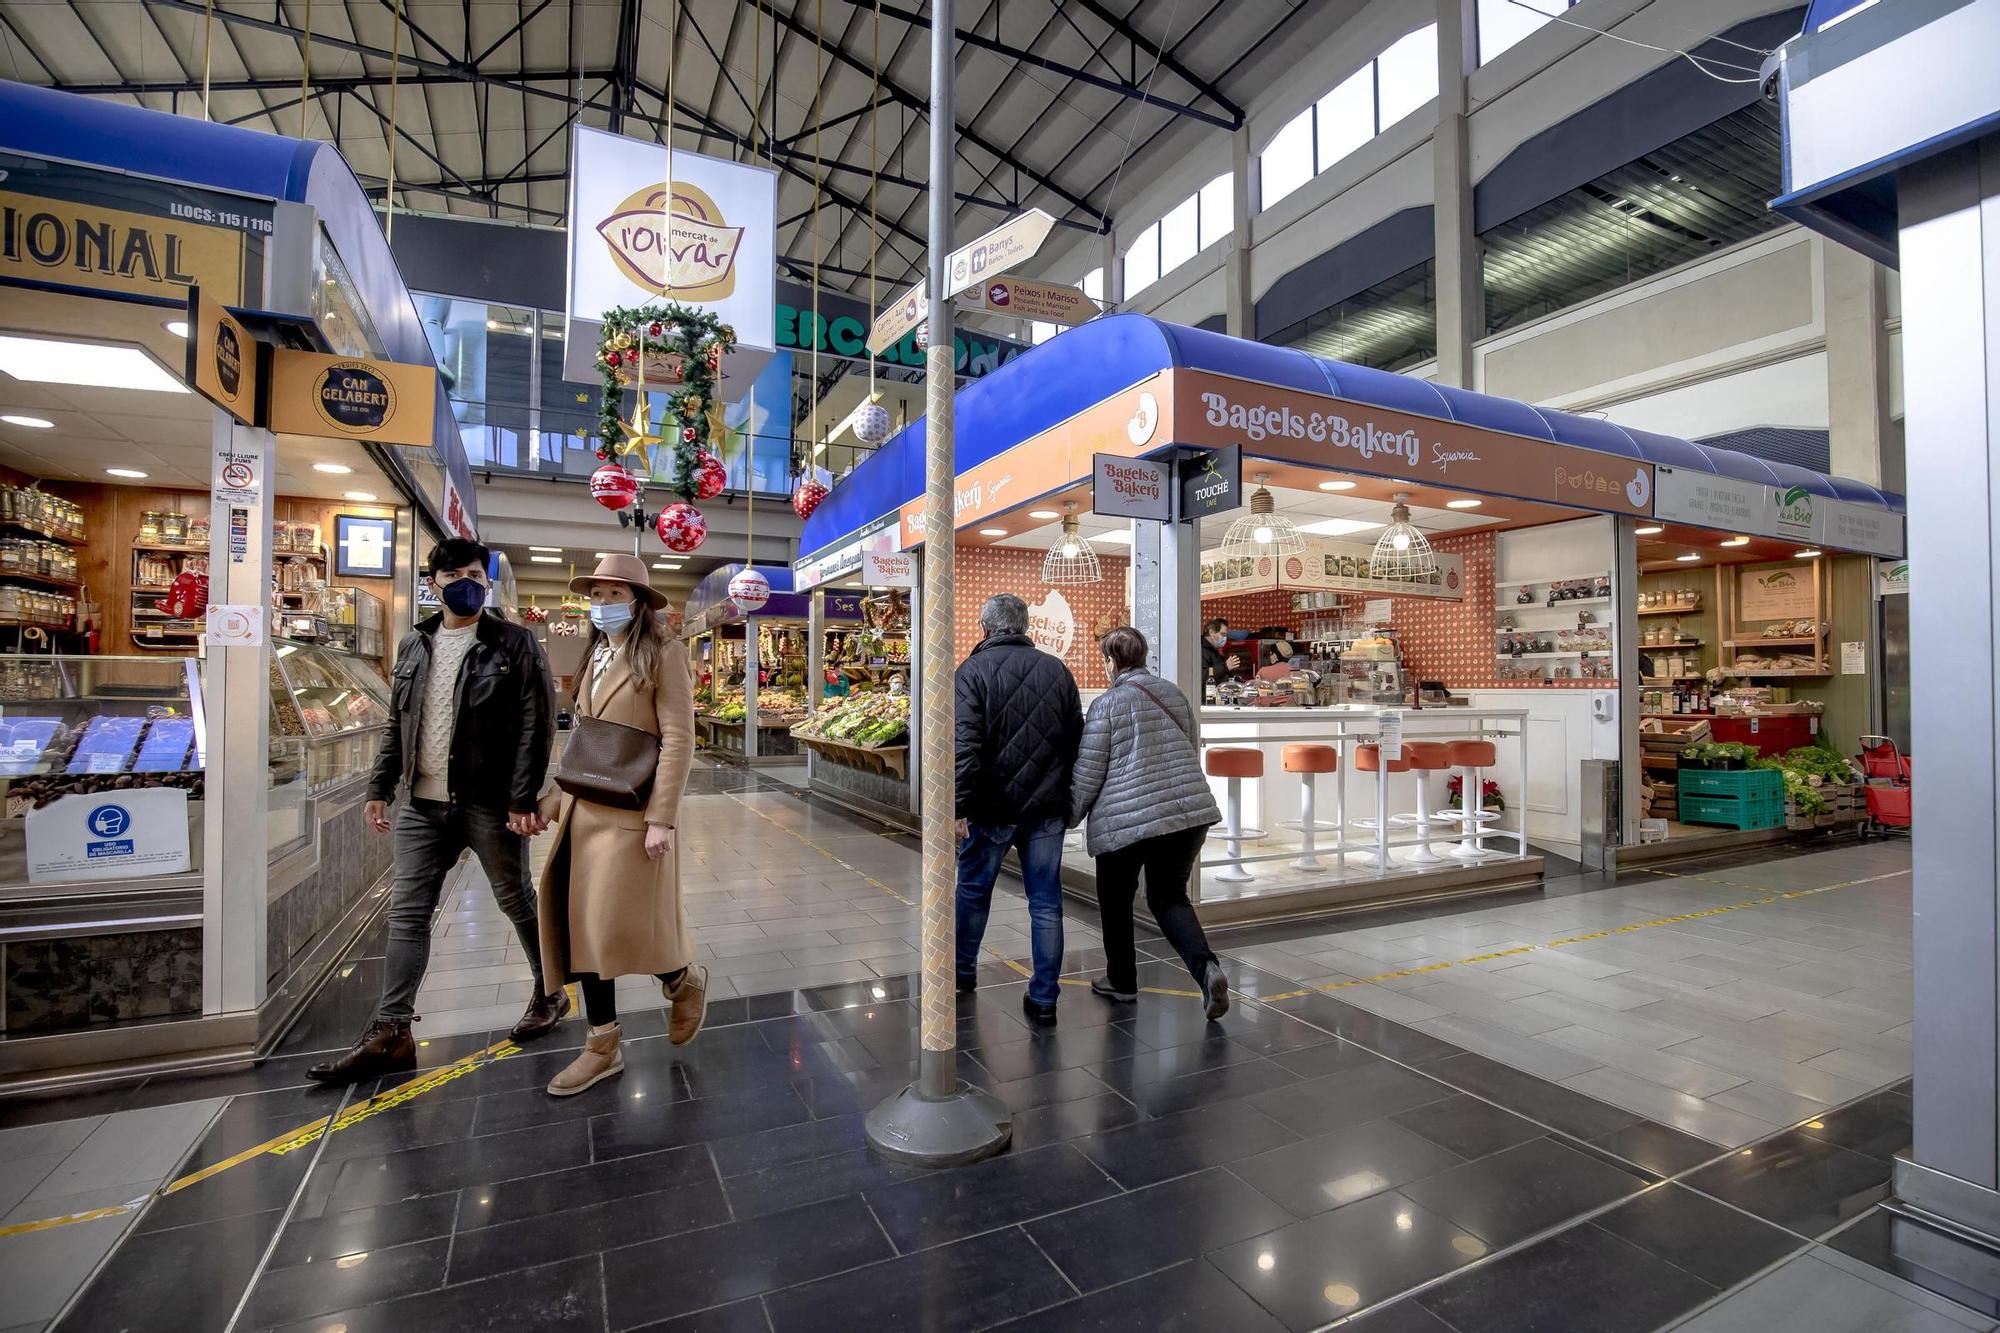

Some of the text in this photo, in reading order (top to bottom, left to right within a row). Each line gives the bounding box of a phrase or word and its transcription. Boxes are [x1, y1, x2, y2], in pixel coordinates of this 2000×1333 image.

[170, 202, 273, 232] LLOCS: 115 i 116
[672, 229, 708, 242] mercat
[989, 235, 1013, 254] Banys
[621, 227, 728, 268] l'Olvar
[1014, 285, 1079, 305] Peixos i Mariscs
[1014, 296, 1040, 306] Pescados
[1046, 301, 1071, 311] Mariscos
[1027, 306, 1038, 314] and
[1050, 310, 1064, 318] Food
[342, 377, 369, 392] CAN
[322, 388, 388, 406] GELABERT
[1113, 479, 1160, 500] Bakery
[1195, 479, 1229, 501] TOUCHÉ
[1794, 505, 1813, 523] Bio
[877, 564, 910, 578] Bakery
[835, 599, 854, 611] Ses
